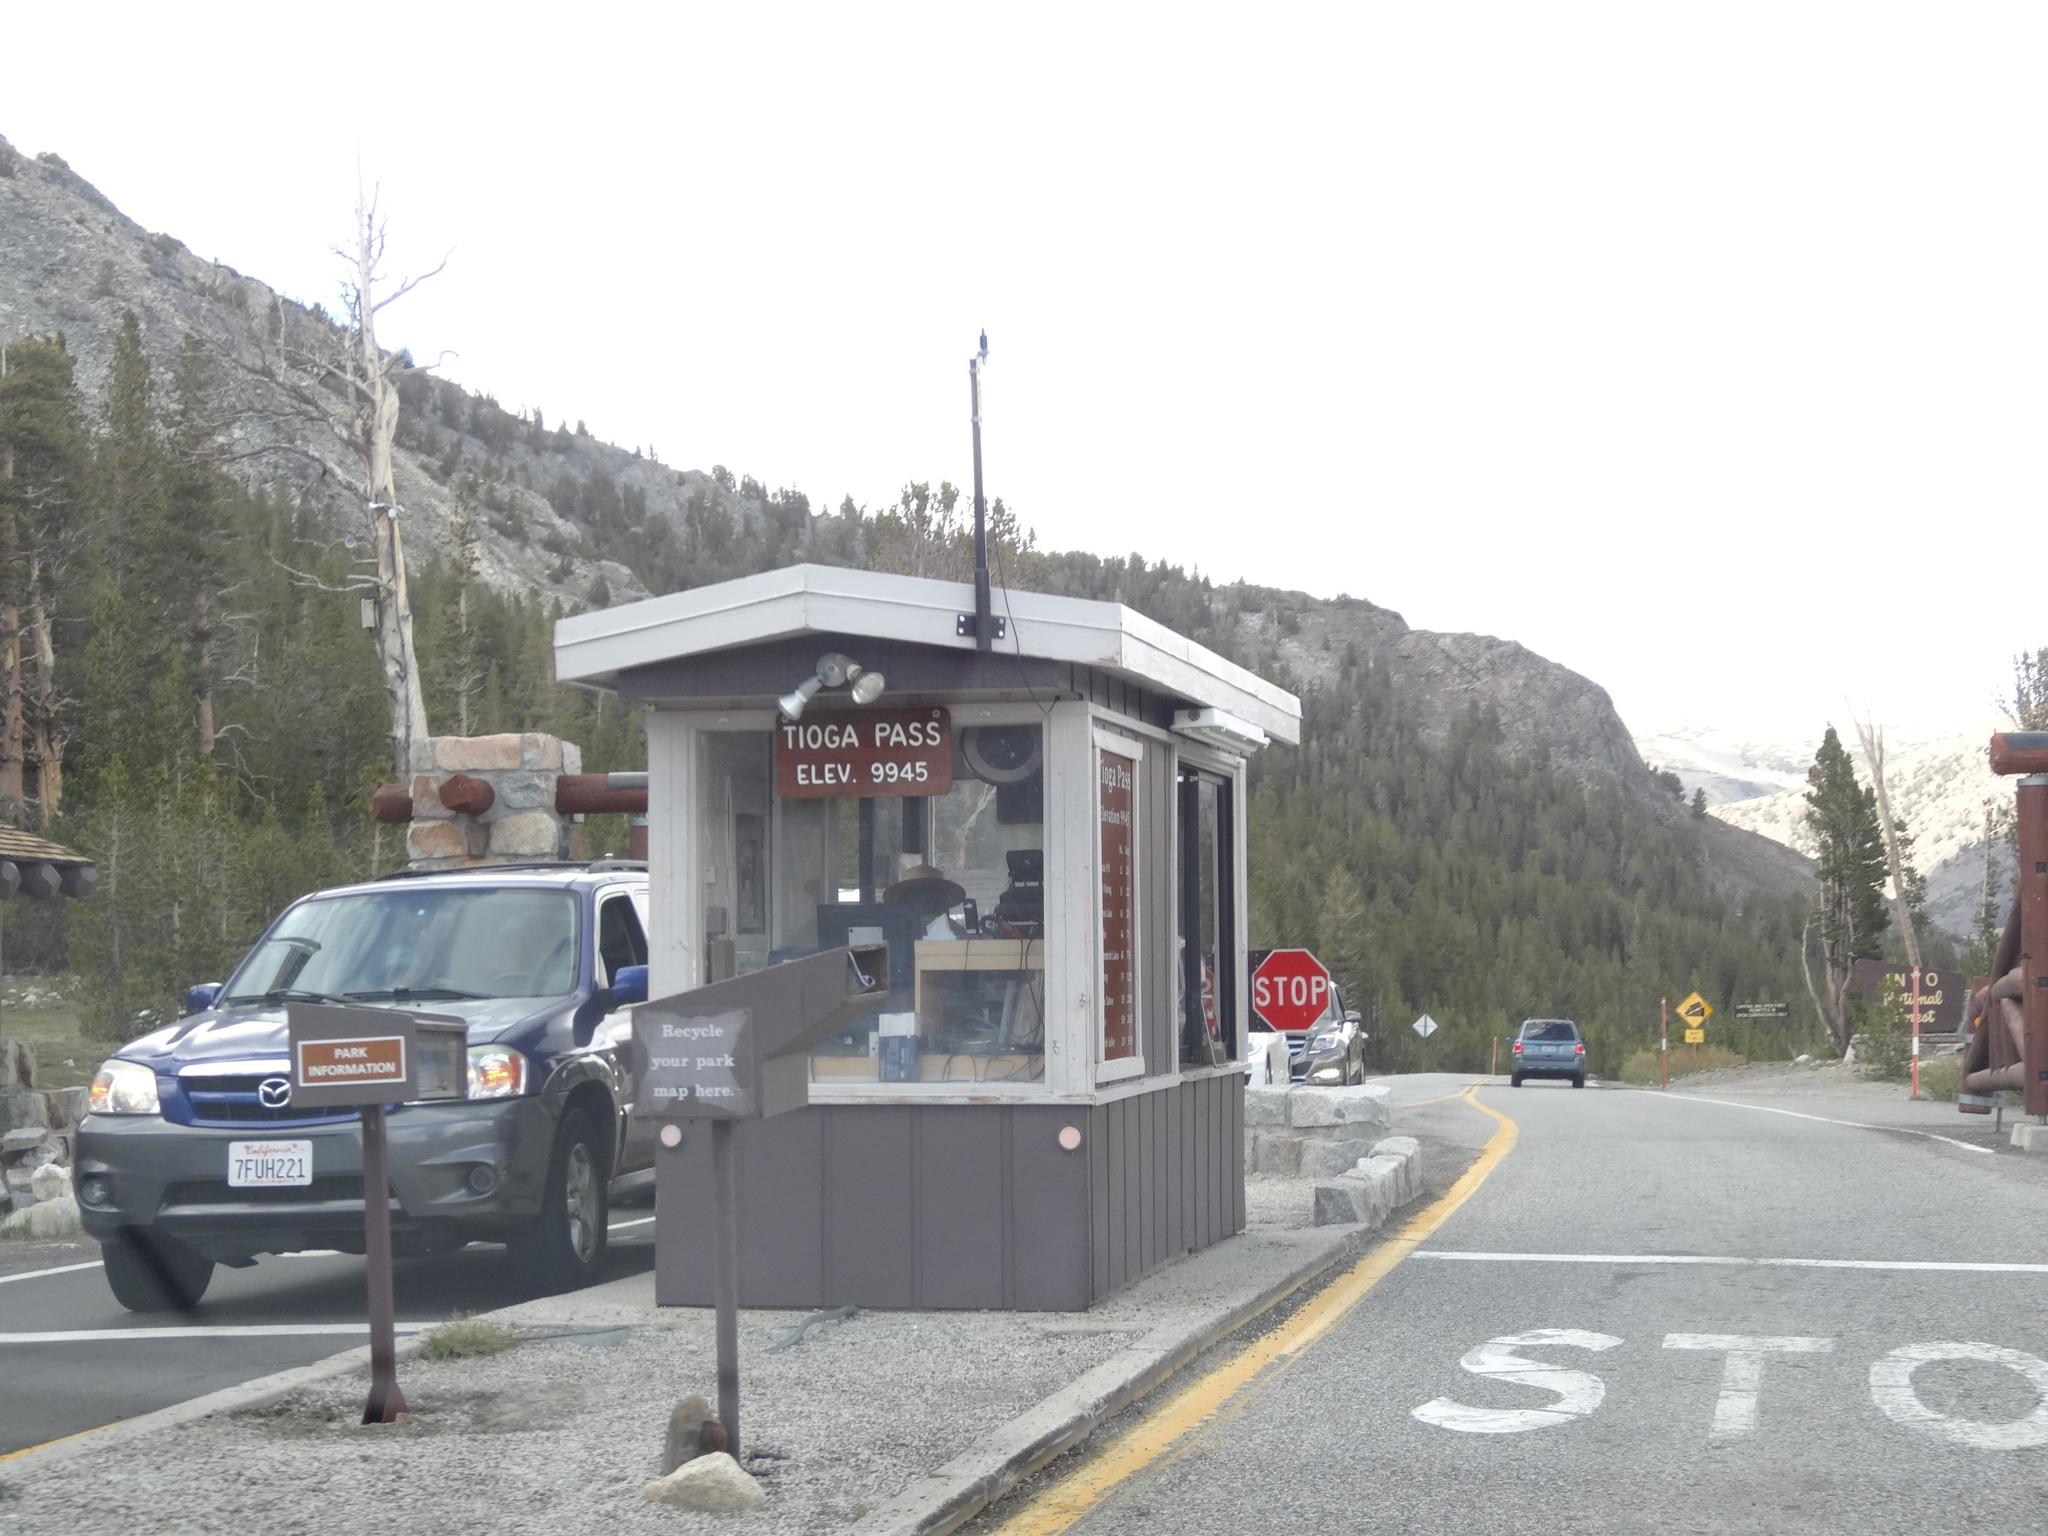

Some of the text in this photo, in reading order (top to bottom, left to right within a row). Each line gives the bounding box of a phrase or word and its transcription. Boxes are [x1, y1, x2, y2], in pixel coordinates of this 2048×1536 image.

[783, 722, 941, 749] TIOGA PASS
[797, 761, 928, 785] ELEV. 9945
[1100, 760, 1131, 793] ioga Pass
[1885, 971, 1938, 987] INO
[1255, 975, 1327, 1006] STOP
[1883, 990, 1943, 1006] Ntinal
[1894, 1008, 1936, 1023] rest
[661, 1024, 724, 1040] Recycle
[334, 1047, 368, 1059] PARK
[308, 1062, 396, 1077] INFORMATION
[650, 1054, 735, 1070] your park
[653, 1084, 735, 1100] map here.
[235, 1158, 305, 1179] 7FUH221
